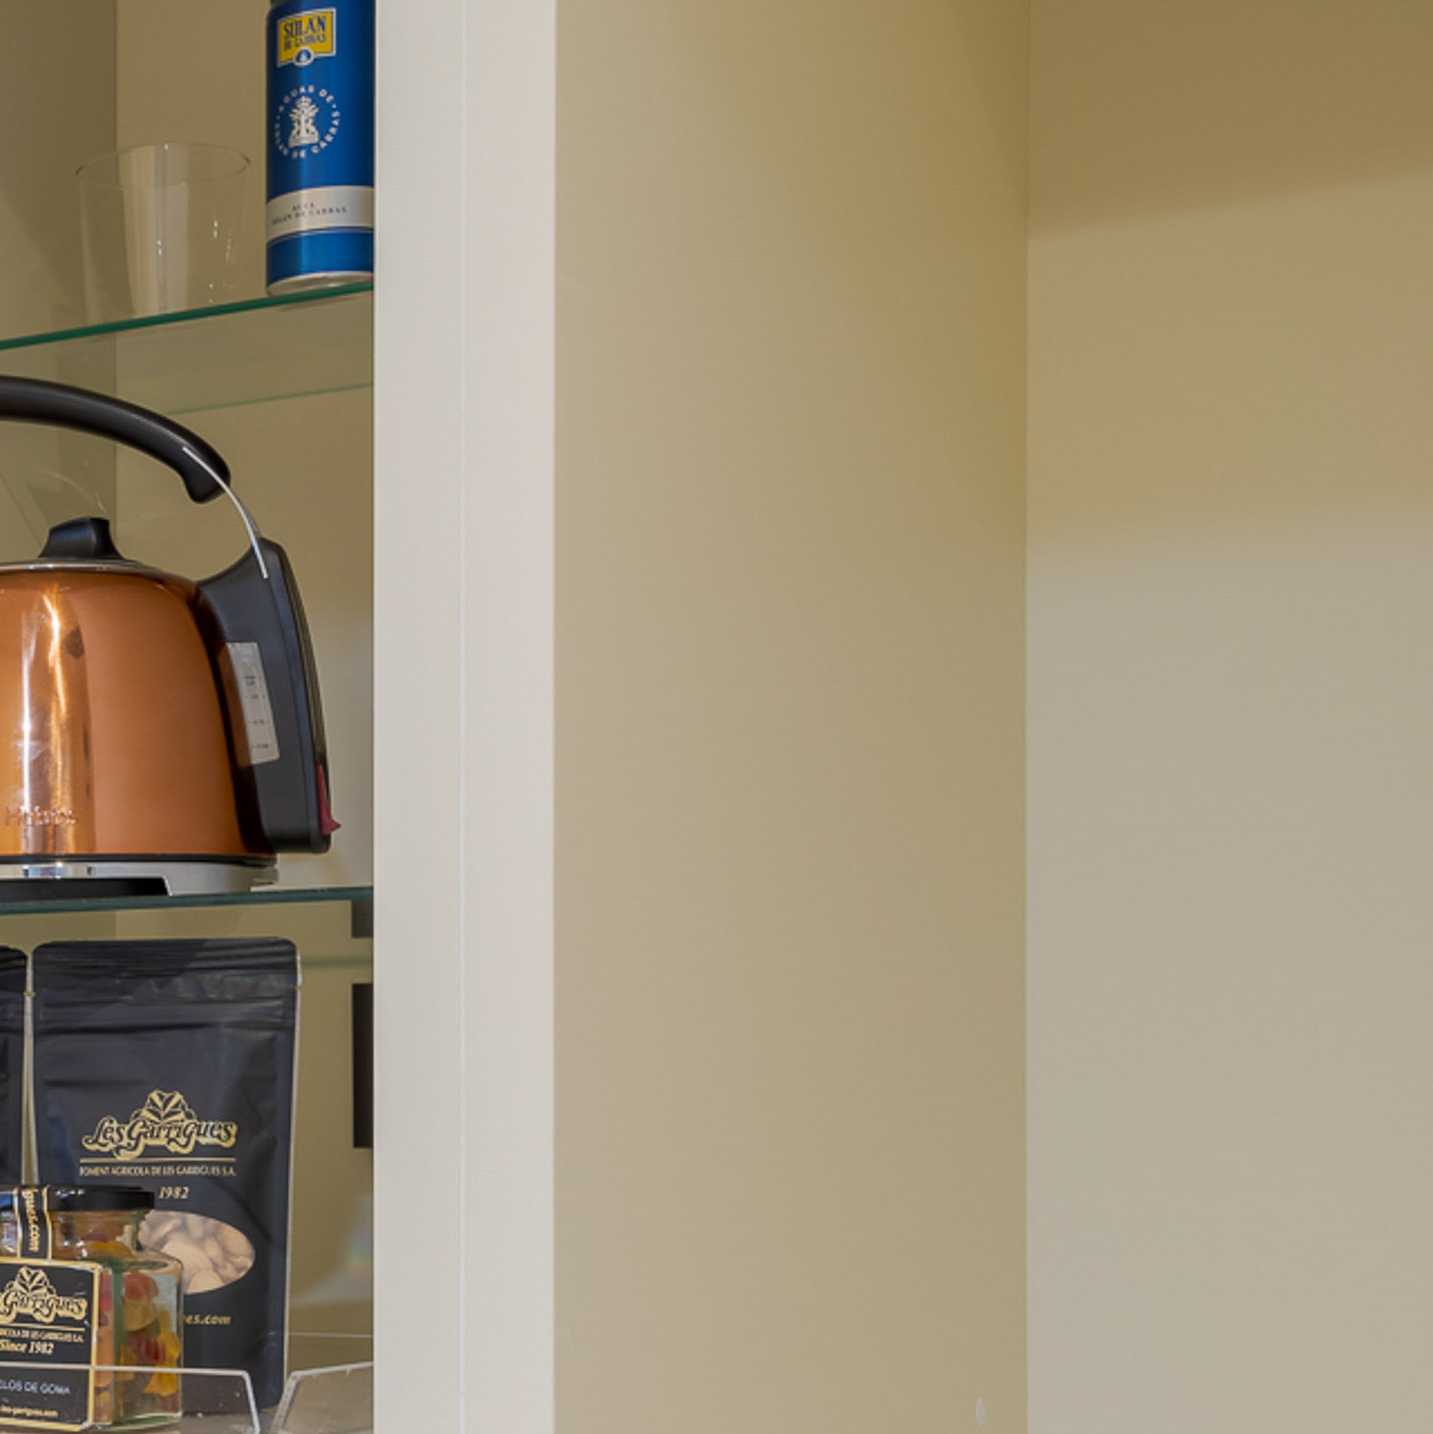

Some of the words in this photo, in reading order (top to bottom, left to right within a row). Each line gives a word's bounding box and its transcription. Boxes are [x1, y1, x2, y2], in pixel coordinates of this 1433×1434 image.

[158, 1186, 190, 1199] 1982
[28, 1341, 54, 1355] 1982
[24, 1381, 38, 1393] DE
